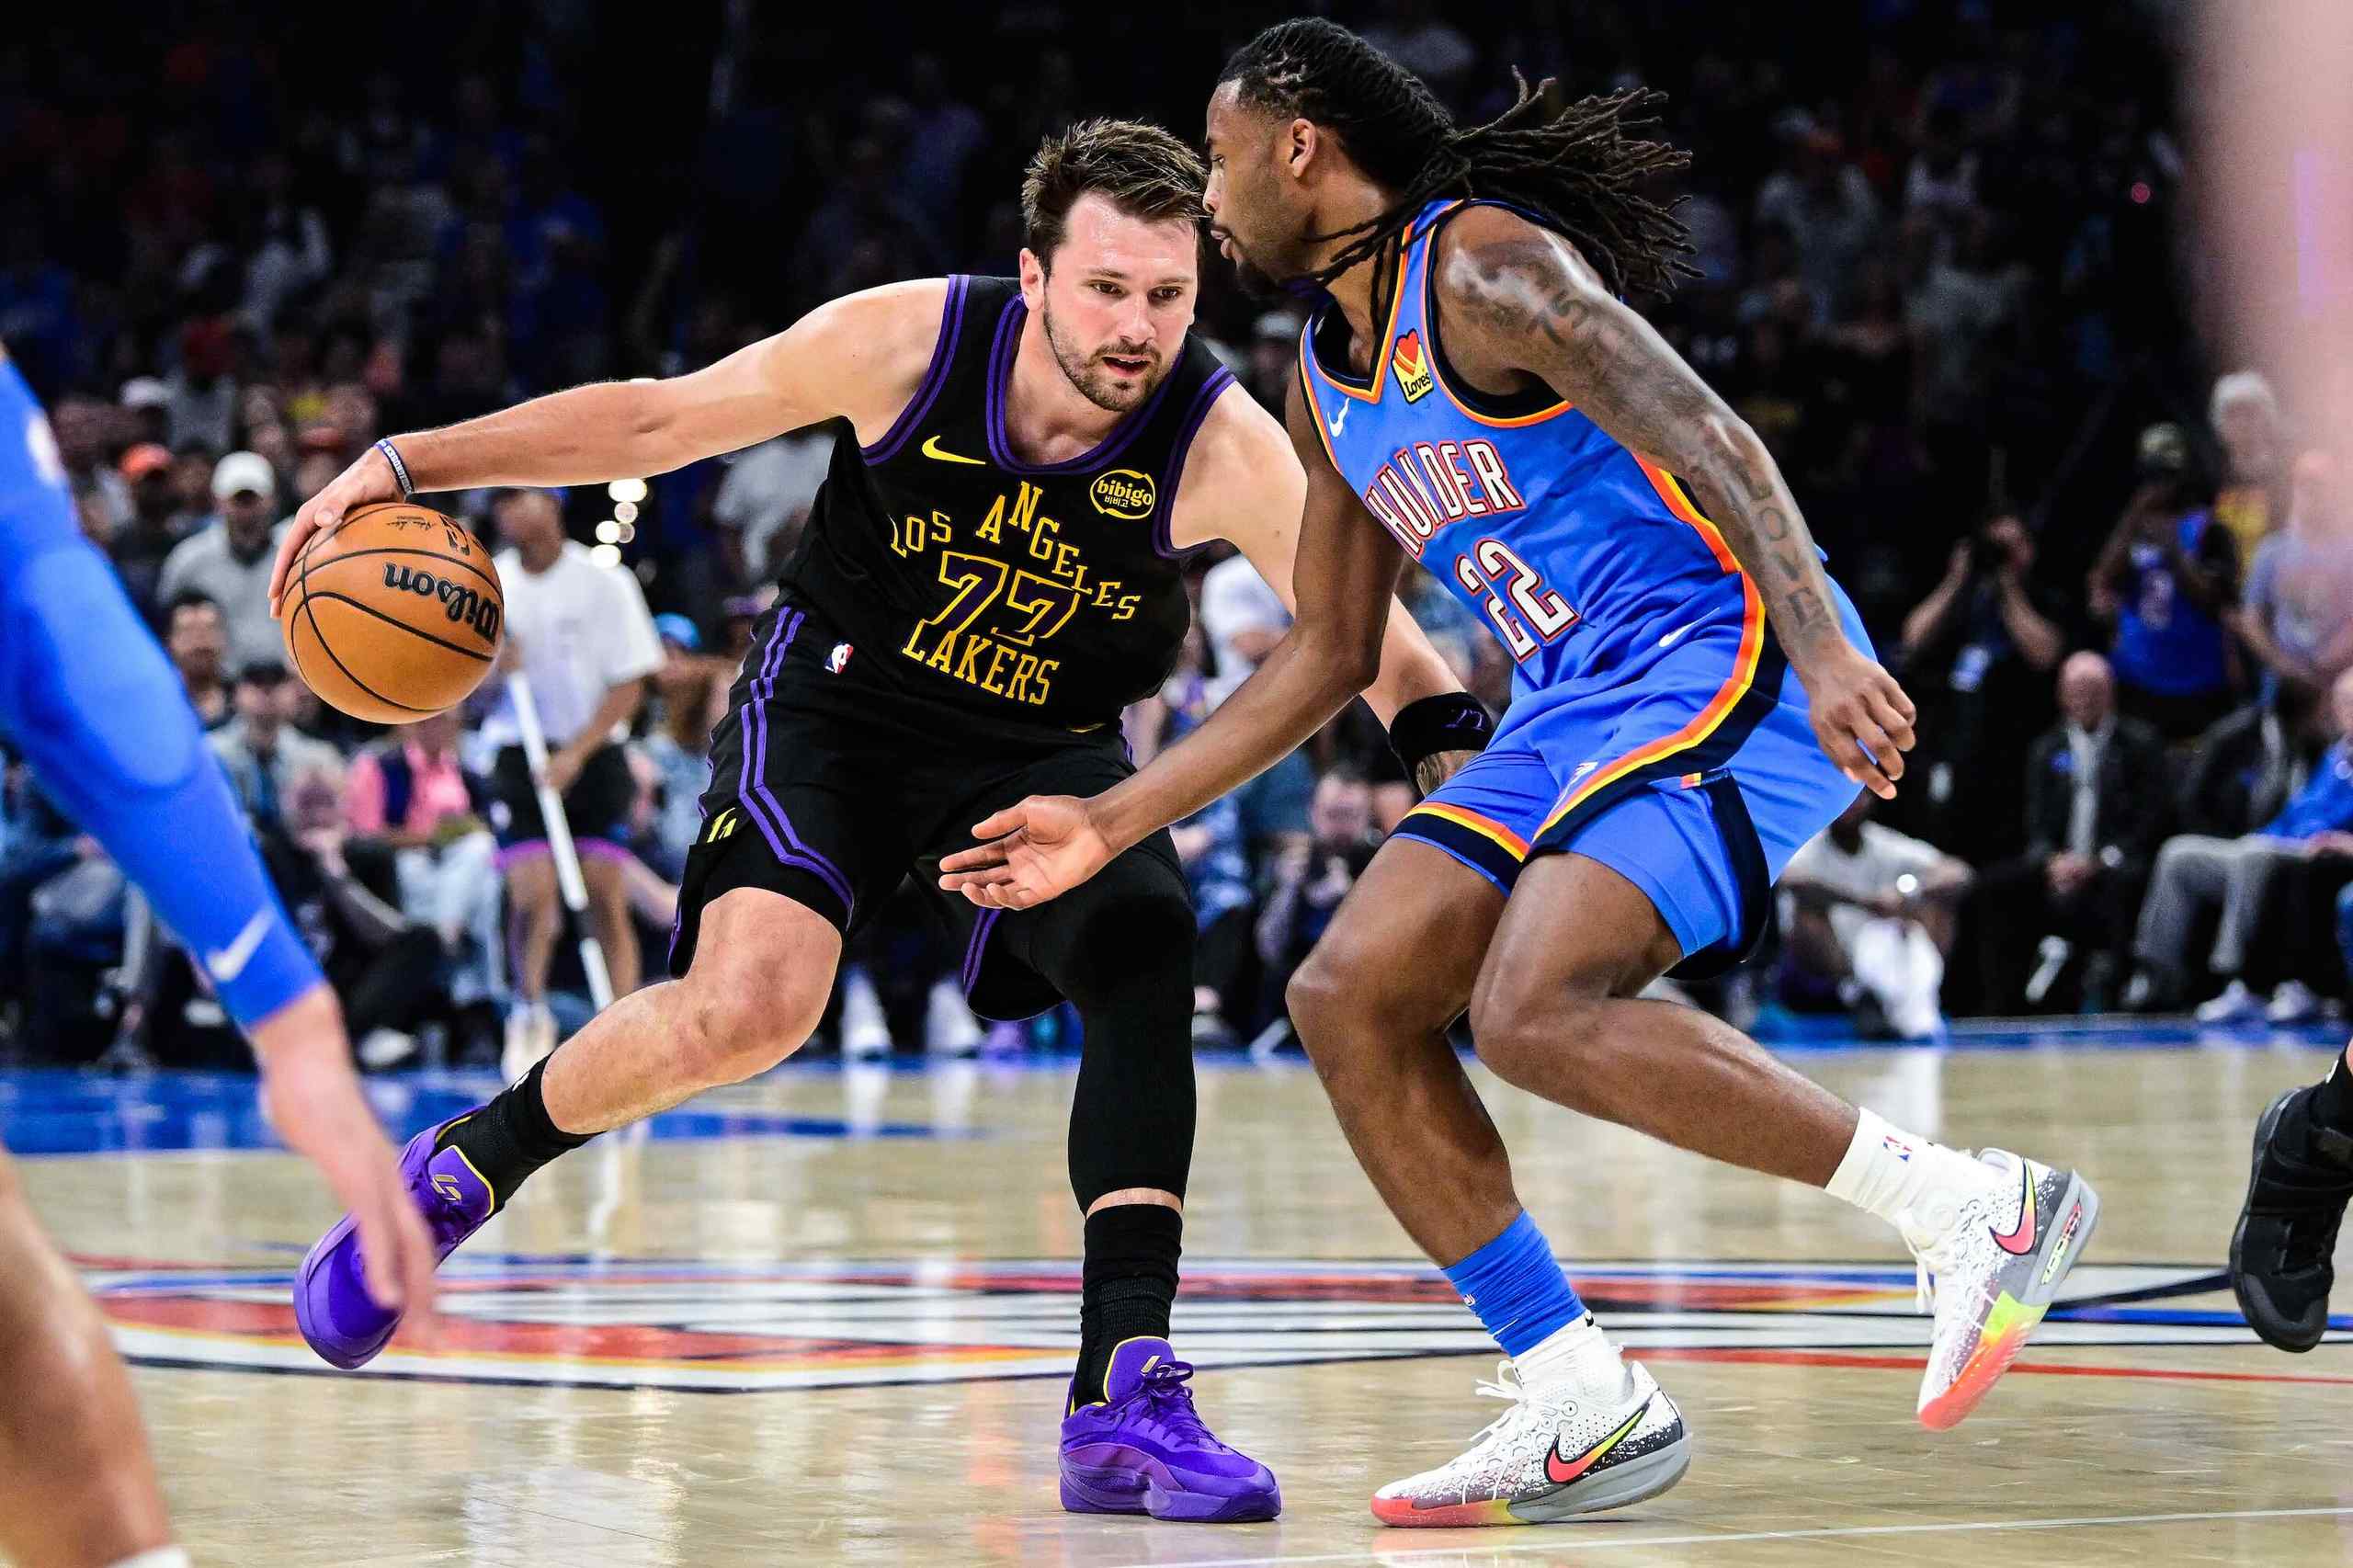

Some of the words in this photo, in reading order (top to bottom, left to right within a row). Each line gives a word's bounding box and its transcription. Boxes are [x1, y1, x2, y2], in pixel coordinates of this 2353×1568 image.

[1097, 479, 1153, 507] bibigo
[1364, 437, 1527, 562] HUNDER
[887, 509, 952, 558] LOS
[975, 481, 1142, 619] ANGELES
[938, 550, 1081, 647] 77
[382, 562, 500, 645] Wilson
[1455, 537, 1581, 663] 22
[901, 618, 1060, 705] LAKERS
